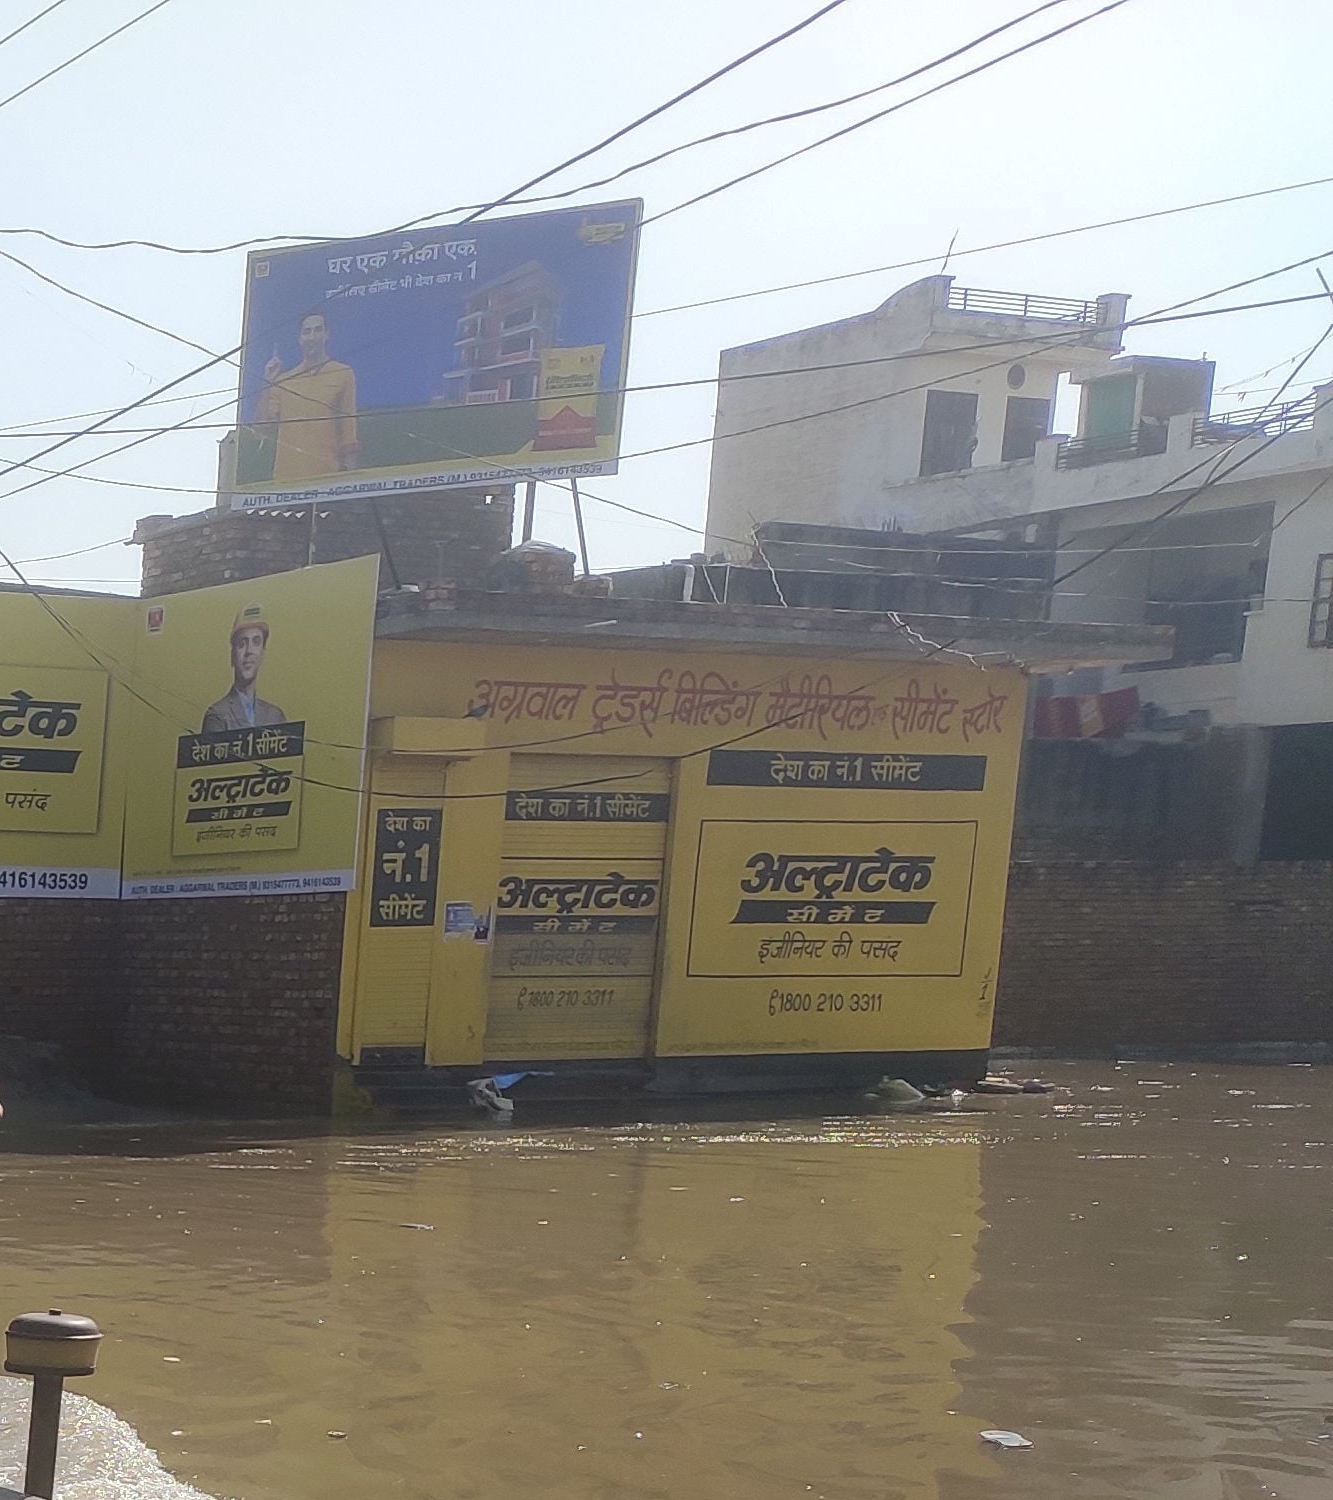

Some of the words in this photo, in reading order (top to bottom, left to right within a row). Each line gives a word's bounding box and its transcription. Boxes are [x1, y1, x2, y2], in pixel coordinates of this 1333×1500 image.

[327, 256, 353, 274] घर
[355, 251, 389, 275] एक
[399, 275, 412, 289] भी
[415, 274, 434, 287] देश
[435, 273, 452, 284] का
[393, 476, 445, 491] TRADERS
[467, 679, 587, 724] अग्रवाल
[192, 739, 211, 762] देश
[213, 742, 230, 760] का
[255, 728, 289, 755] सीमेंट
[770, 753, 802, 784] देश
[807, 760, 830, 780] का
[870, 755, 923, 782] सीमेंट
[188, 764, 293, 804] अल्ट्राटेक
[4, 788, 52, 812] पसंद
[515, 794, 542, 818] देश
[549, 799, 570, 817] का
[606, 795, 651, 818] सीमेंट
[385, 811, 407, 833] देश
[412, 816, 432, 832] का
[382, 840, 430, 883] नं.1
[740, 847, 936, 899] अल्ट्राटेक
[179, 880, 216, 894] AGGARWAL
[497, 872, 659, 914] अल्ट्राटेक
[379, 895, 427, 921] सीमेंट
[831, 931, 853, 959] की
[556, 990, 579, 1007] 210
[582, 989, 614, 1006] 3311
[778, 993, 812, 1012] 1800
[816, 993, 844, 1012] 210
[849, 993, 883, 1012] 3311
